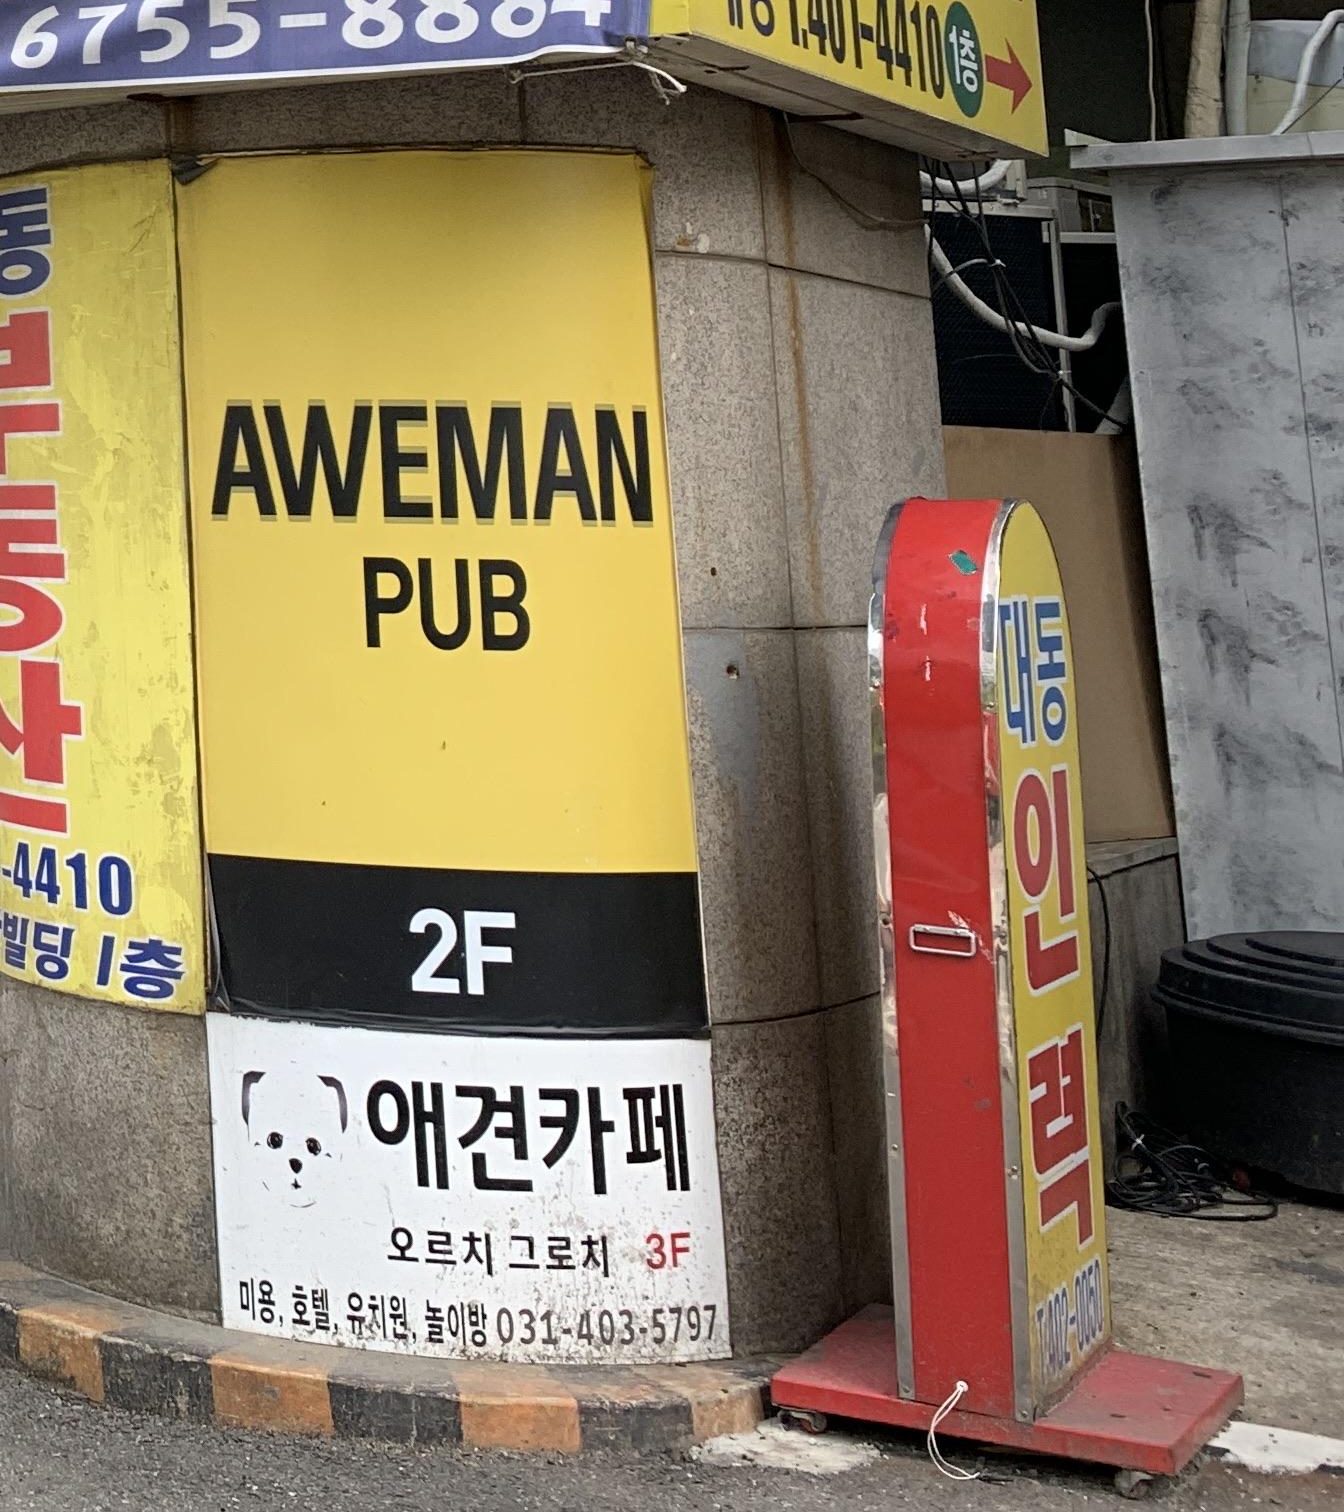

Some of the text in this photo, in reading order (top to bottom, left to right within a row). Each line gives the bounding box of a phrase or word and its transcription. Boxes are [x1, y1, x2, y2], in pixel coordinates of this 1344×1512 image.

[948, 23, 980, 95] 1층
[210, 400, 656, 527] AWEMAN
[362, 554, 533, 654] PUB
[407, 907, 518, 997] 2F
[1011, 767, 1097, 1253] 인력
[365, 1077, 693, 1197] 애견카페
[386, 1226, 693, 1279] 오르치 그로치 3F
[423, 1298, 489, 1348] 놀이방
[496, 1304, 719, 1350] 031-403-5797
